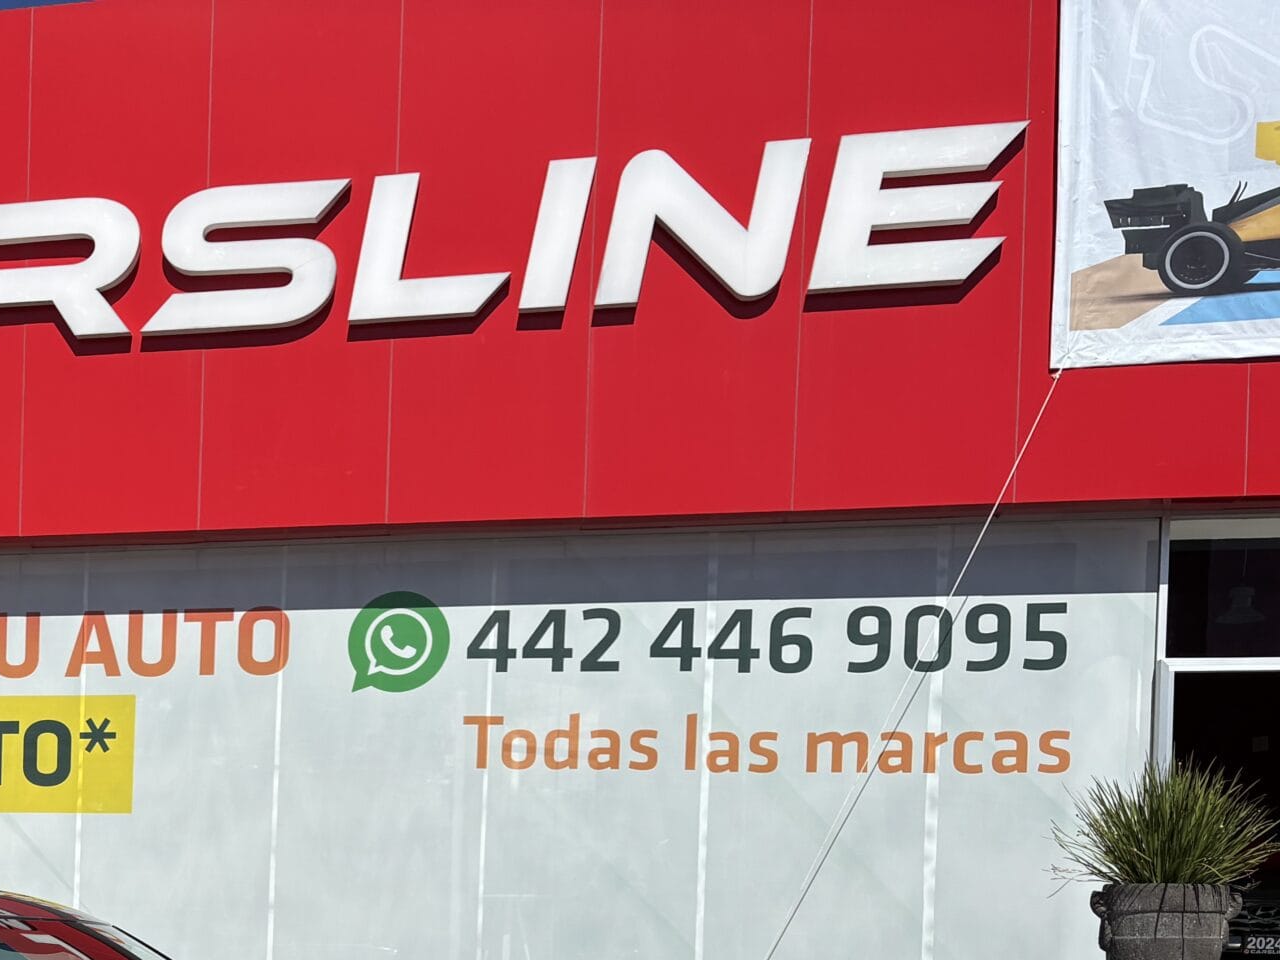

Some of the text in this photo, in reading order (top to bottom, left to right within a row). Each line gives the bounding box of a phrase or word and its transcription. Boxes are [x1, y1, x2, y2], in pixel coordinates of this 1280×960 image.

[64, 605, 290, 678] AUTO
[466, 602, 1068, 674] 442 446 9095
[463, 712, 1071, 774] Todas las marcas
